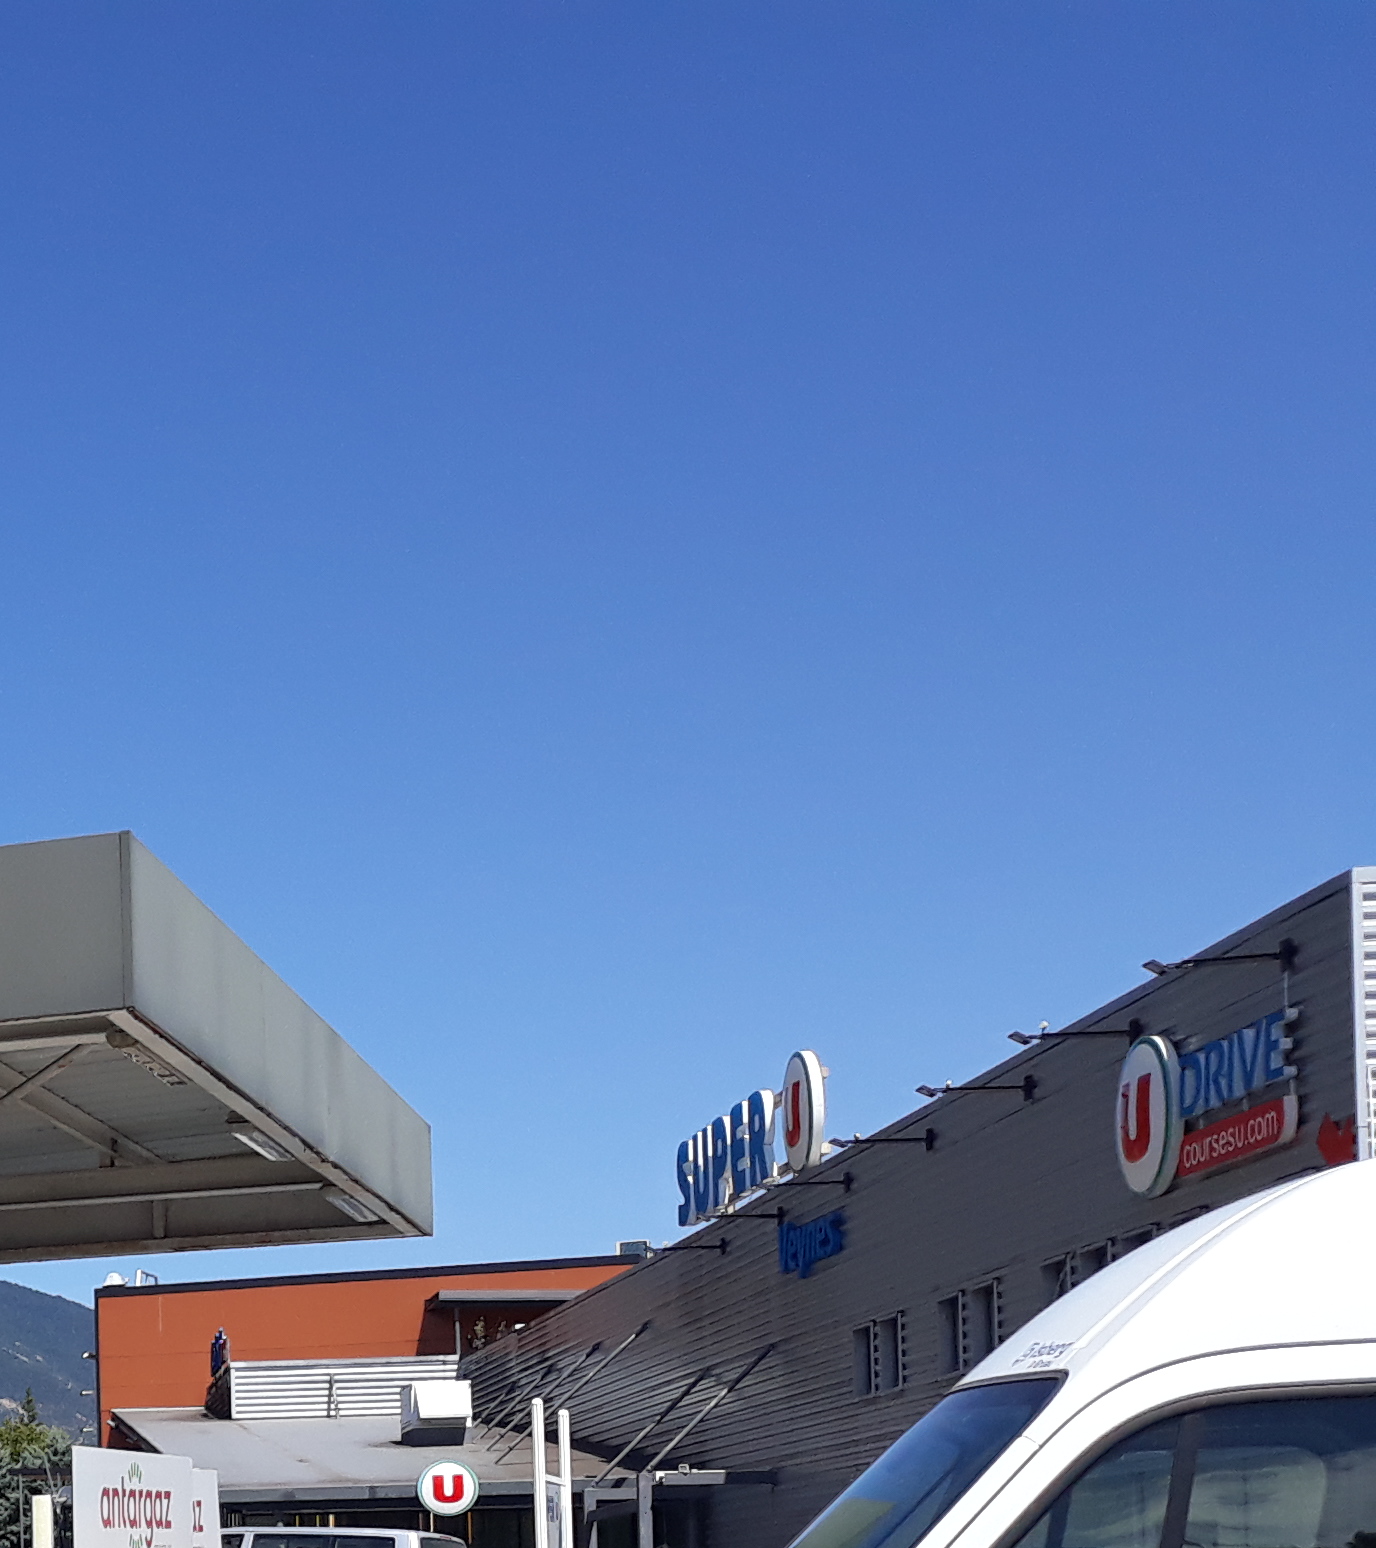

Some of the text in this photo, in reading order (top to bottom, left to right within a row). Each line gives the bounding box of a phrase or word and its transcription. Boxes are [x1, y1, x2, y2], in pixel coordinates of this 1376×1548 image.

[1178, 1008, 1290, 1118] DRIVE
[676, 1087, 776, 1227] SUPER
[1182, 1110, 1279, 1169] coursesu.com
[100, 1475, 172, 1548] antargaz
[432, 1474, 464, 1503] U
